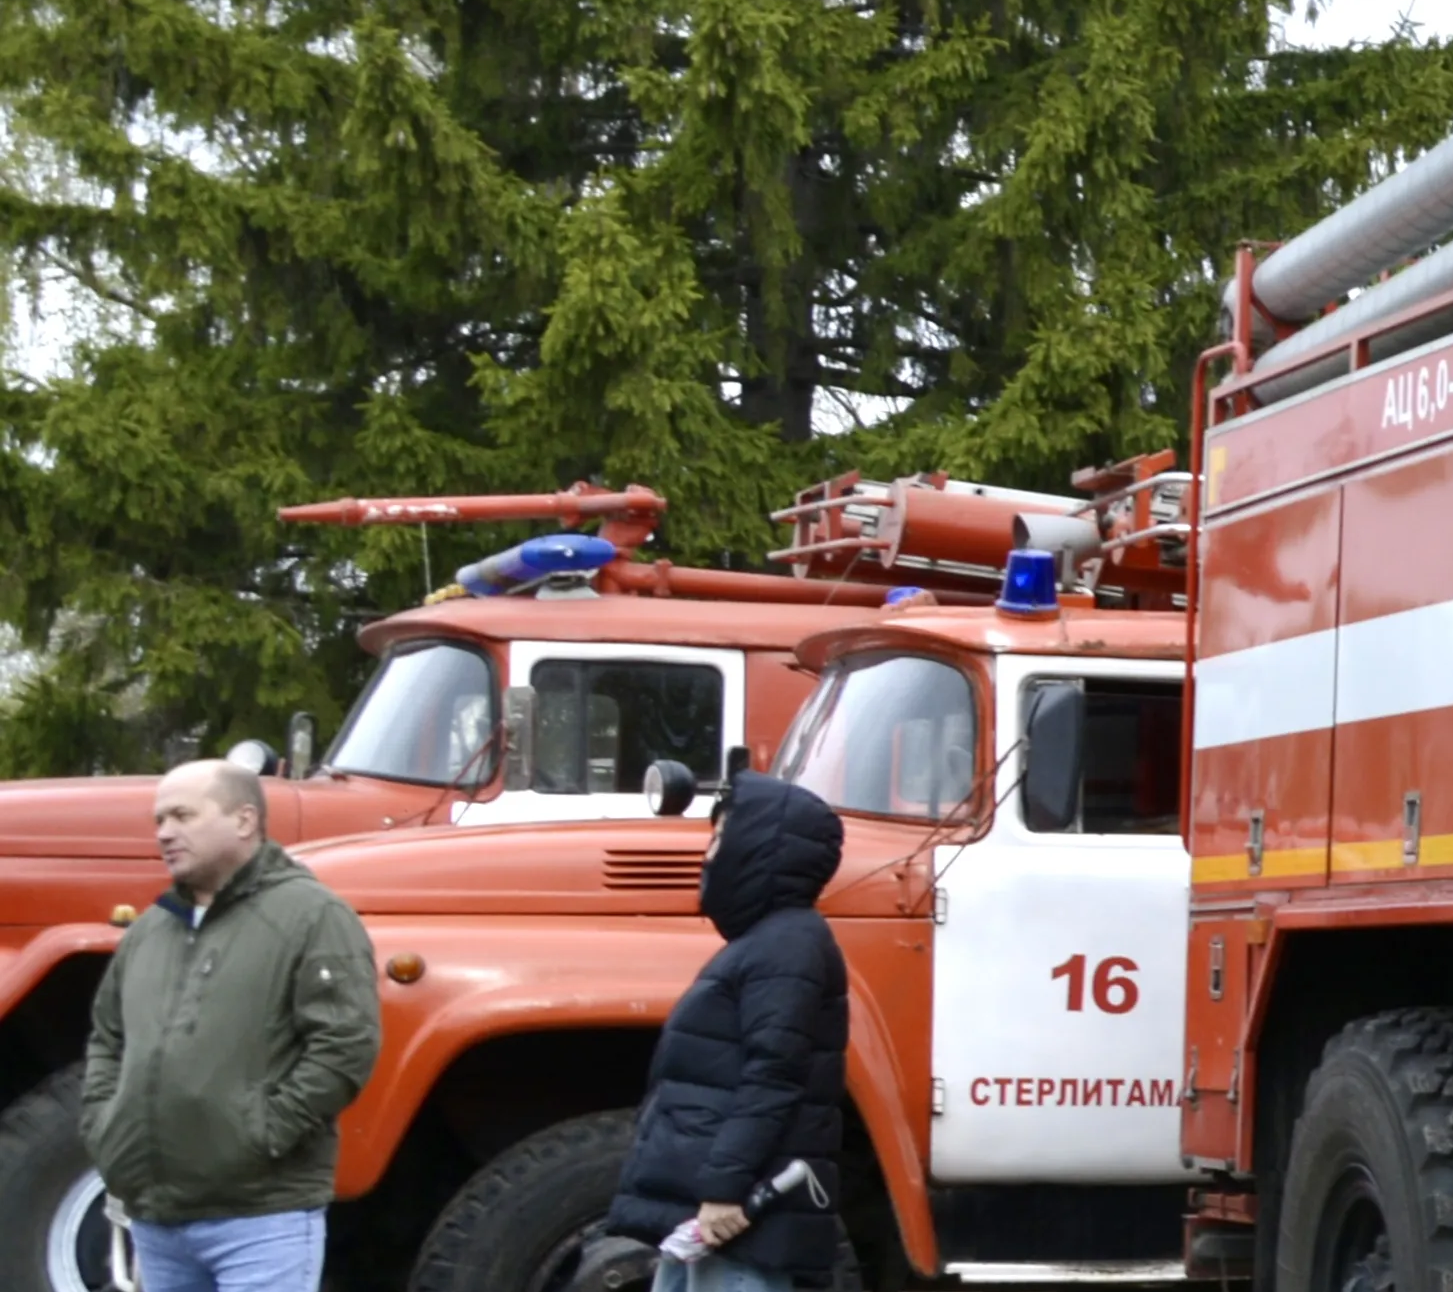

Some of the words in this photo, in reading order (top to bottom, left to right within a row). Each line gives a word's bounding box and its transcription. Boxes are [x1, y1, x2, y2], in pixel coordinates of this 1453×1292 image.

[1381, 377, 1414, 431] АЦ
[1051, 953, 1140, 1015] 16
[970, 1076, 1184, 1108] СТЕРЛИТАМ
